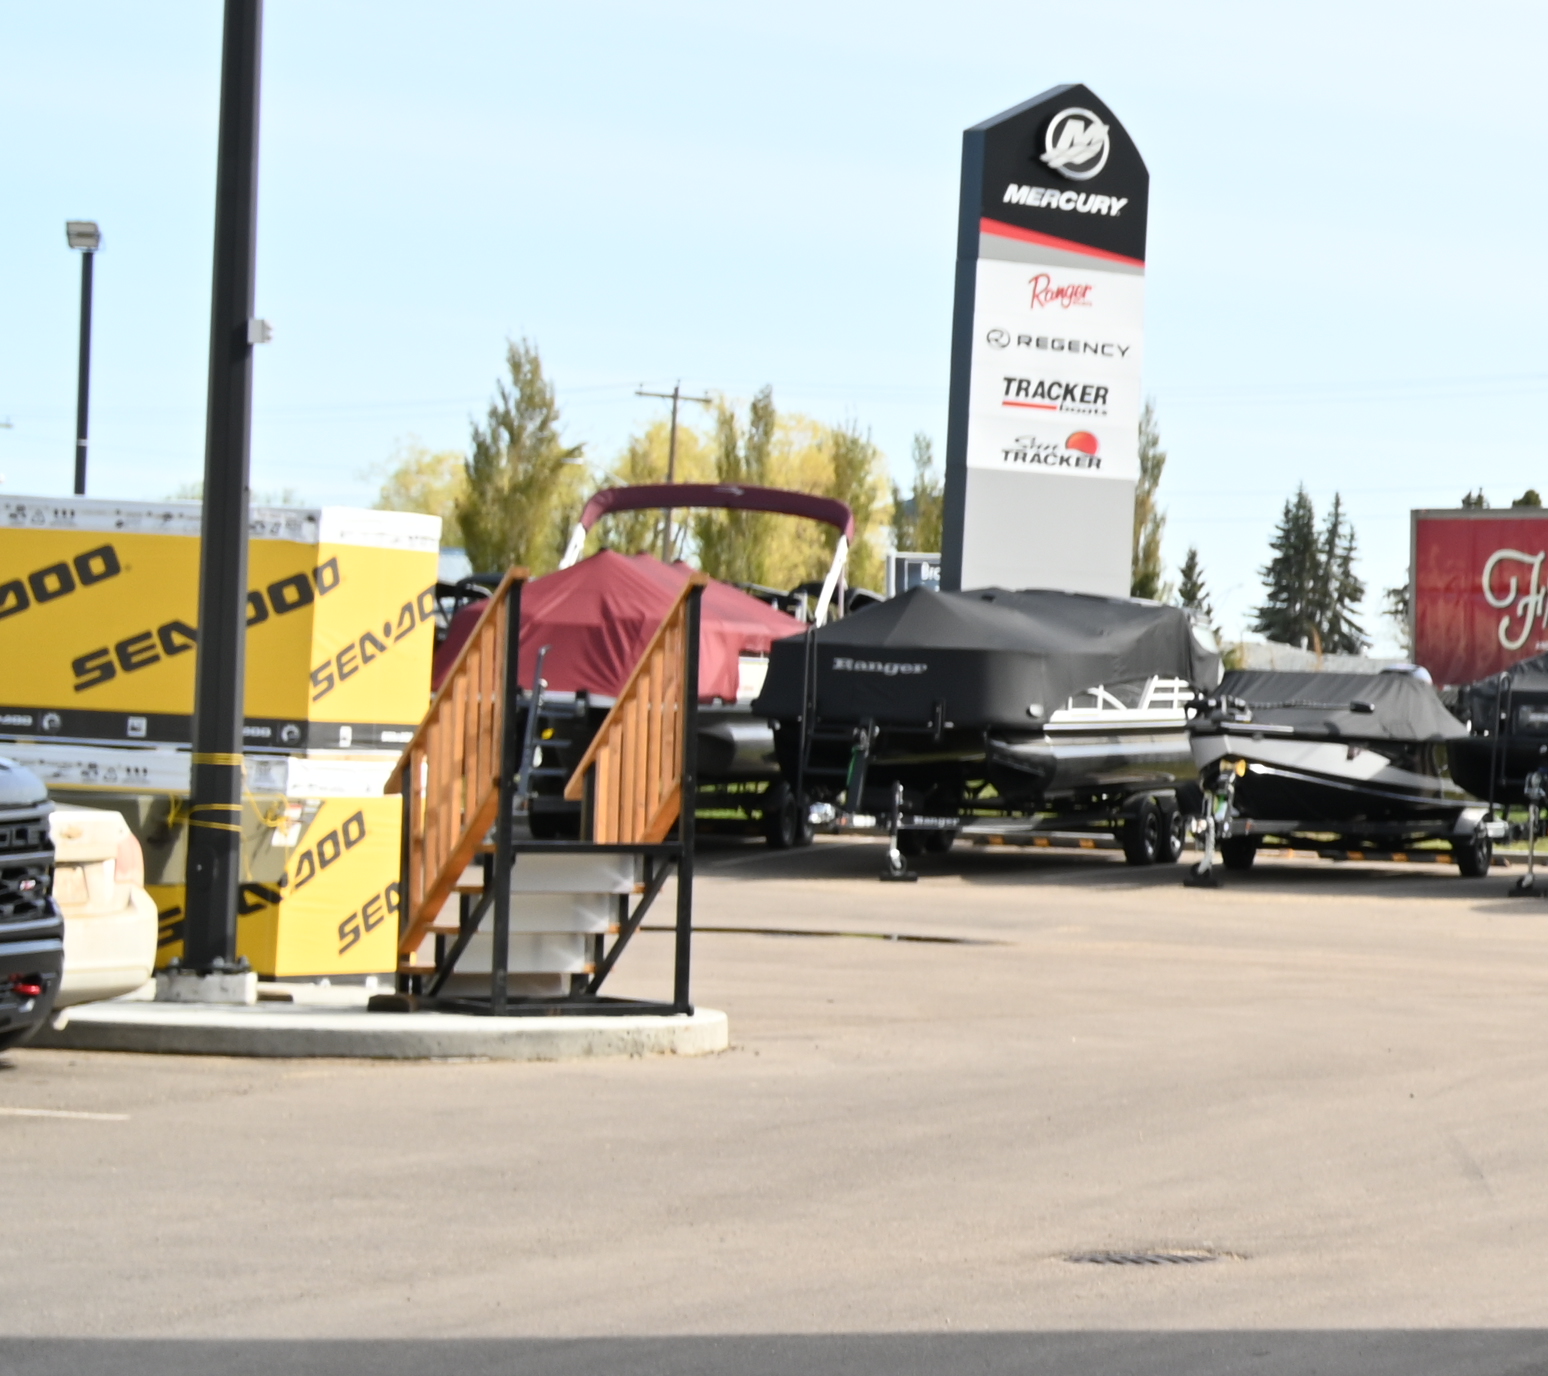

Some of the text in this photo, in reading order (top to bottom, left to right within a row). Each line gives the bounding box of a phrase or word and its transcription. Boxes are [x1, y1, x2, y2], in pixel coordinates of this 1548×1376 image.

[1003, 183, 1128, 216] MERCURY
[1028, 273, 1093, 309] Ranger
[1017, 334, 1130, 357] REGENCY
[1002, 377, 1109, 405] TRACKER
[1001, 448, 1103, 469] TRACKER
[833, 657, 928, 676] Ranger
